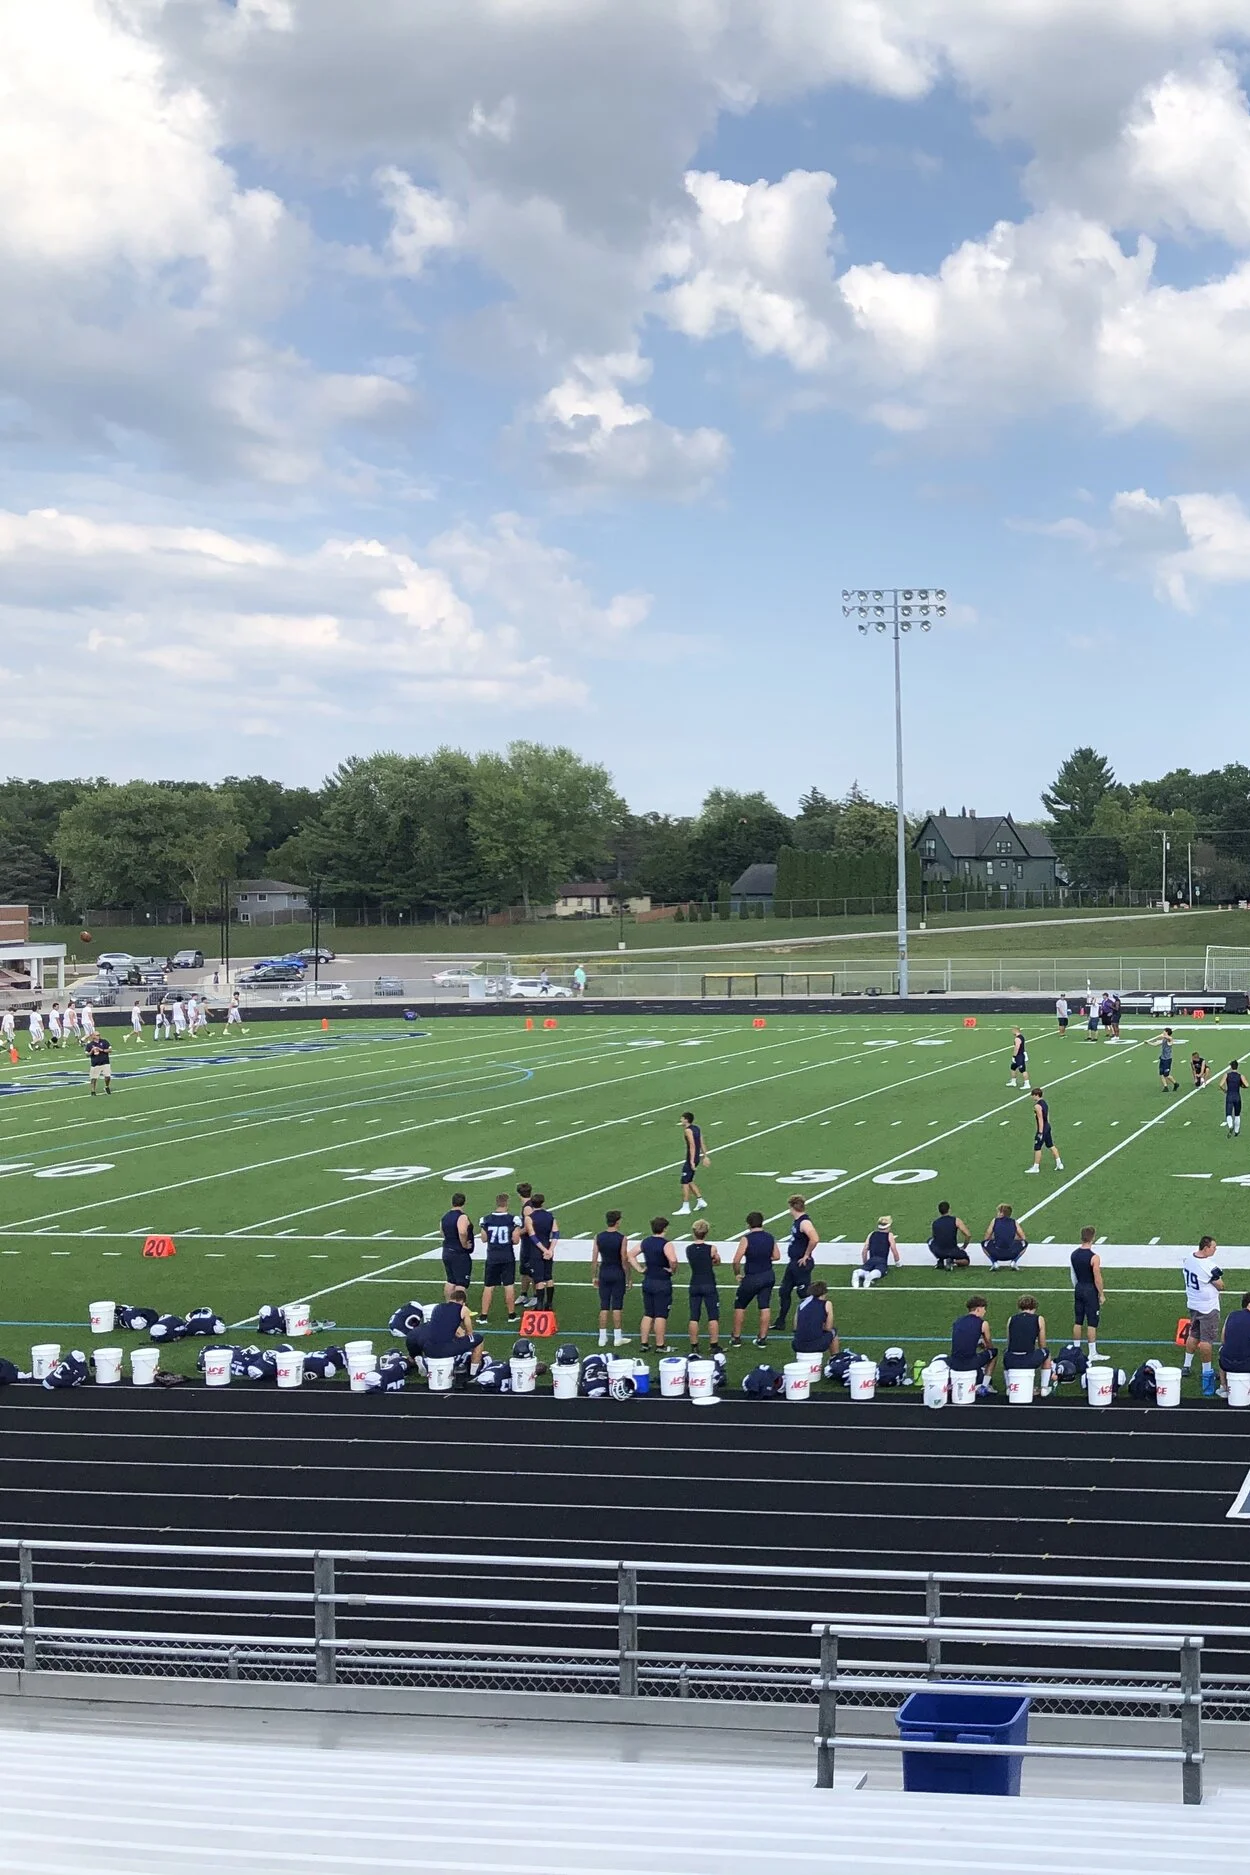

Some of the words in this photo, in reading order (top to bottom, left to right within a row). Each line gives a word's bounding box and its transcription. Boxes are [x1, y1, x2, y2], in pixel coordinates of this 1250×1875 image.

[775, 1168, 939, 1185] 30
[488, 1226, 509, 1244] 70
[144, 1239, 165, 1257] 20
[524, 1314, 549, 1334] 30
[1179, 1323, 1191, 1345] 4
[208, 1367, 225, 1375] ACE
[689, 1378, 706, 1387] ACE
[791, 1380, 808, 1388] ACE
[1008, 1384, 1019, 1392] CE
[1156, 1386, 1167, 1395] CE
